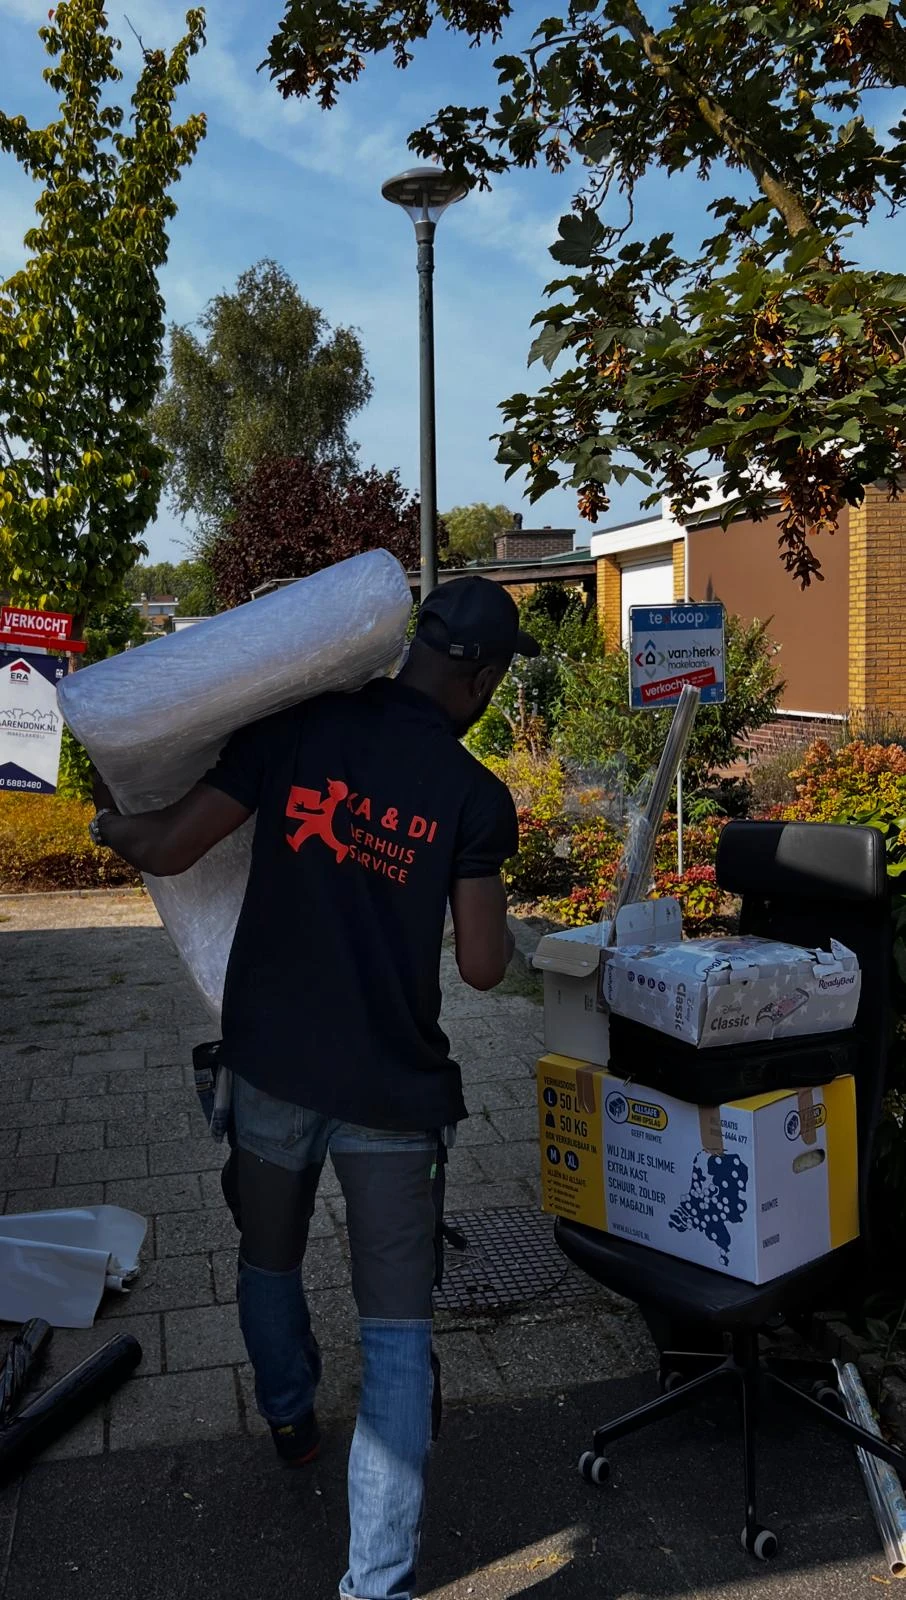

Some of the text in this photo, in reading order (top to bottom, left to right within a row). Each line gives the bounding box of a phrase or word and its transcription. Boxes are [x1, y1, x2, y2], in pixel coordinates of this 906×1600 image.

[4, 612, 68, 633] VERKOCHT
[649, 610, 704, 627] te koop
[10, 672, 28, 680] ERA
[381, 807, 399, 831] &
[408, 815, 438, 843] DI
[818, 975, 855, 990] ReadyBed
[675, 982, 686, 1031] Classic
[710, 1013, 750, 1031] Classic
[560, 1093, 580, 1113] 50 L
[560, 1115, 588, 1137] 50 KG
[567, 1152, 577, 1169] XL
[607, 1143, 675, 1174] WIJ ZIJN JE SLIMME
[607, 1160, 628, 1176] EXTRA
[639, 1185, 666, 1204] ZOLDER
[609, 1192, 654, 1217] OF MAGAZIJN
